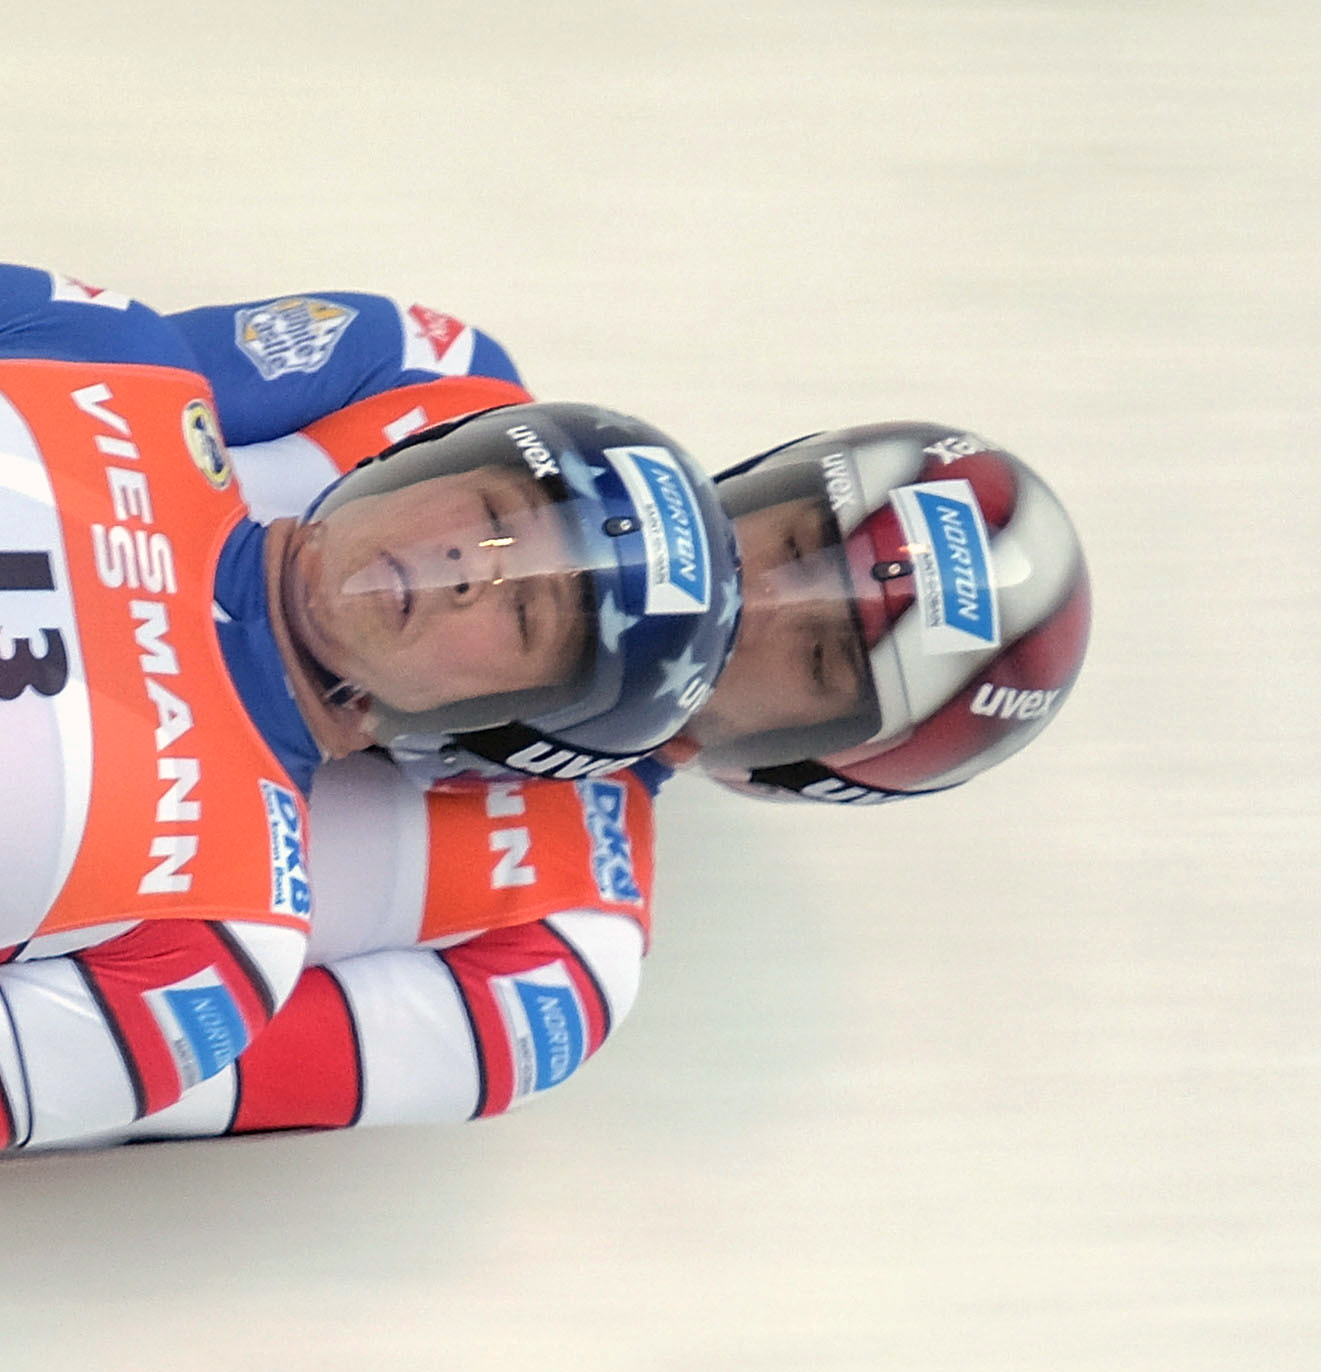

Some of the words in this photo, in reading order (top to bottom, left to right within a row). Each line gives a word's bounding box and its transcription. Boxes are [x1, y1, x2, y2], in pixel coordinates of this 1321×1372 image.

[506, 425, 560, 479] uvex
[822, 452, 854, 512] uvex
[651, 467, 698, 583] NORTON
[936, 505, 980, 621] NORTON
[970, 683, 1061, 720] uvex
[275, 789, 312, 914] DKB
